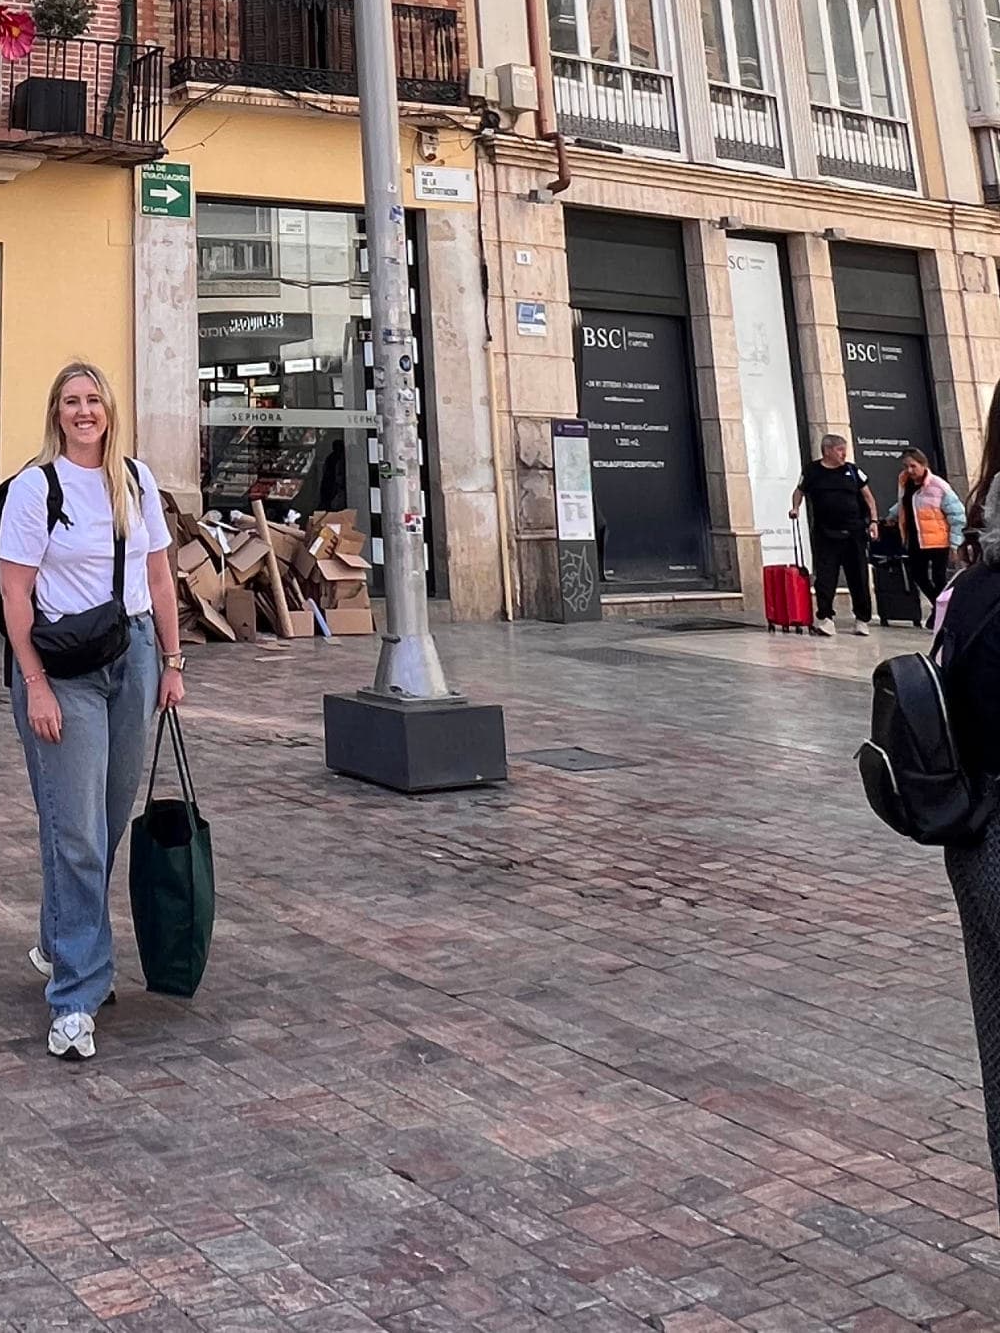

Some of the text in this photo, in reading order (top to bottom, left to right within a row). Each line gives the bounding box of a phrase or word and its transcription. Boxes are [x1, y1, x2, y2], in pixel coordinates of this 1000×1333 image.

[727, 255, 745, 271] SC
[582, 326, 622, 349] BSC
[846, 342, 877, 362] BSC
[231, 412, 282, 422] SEPHORA
